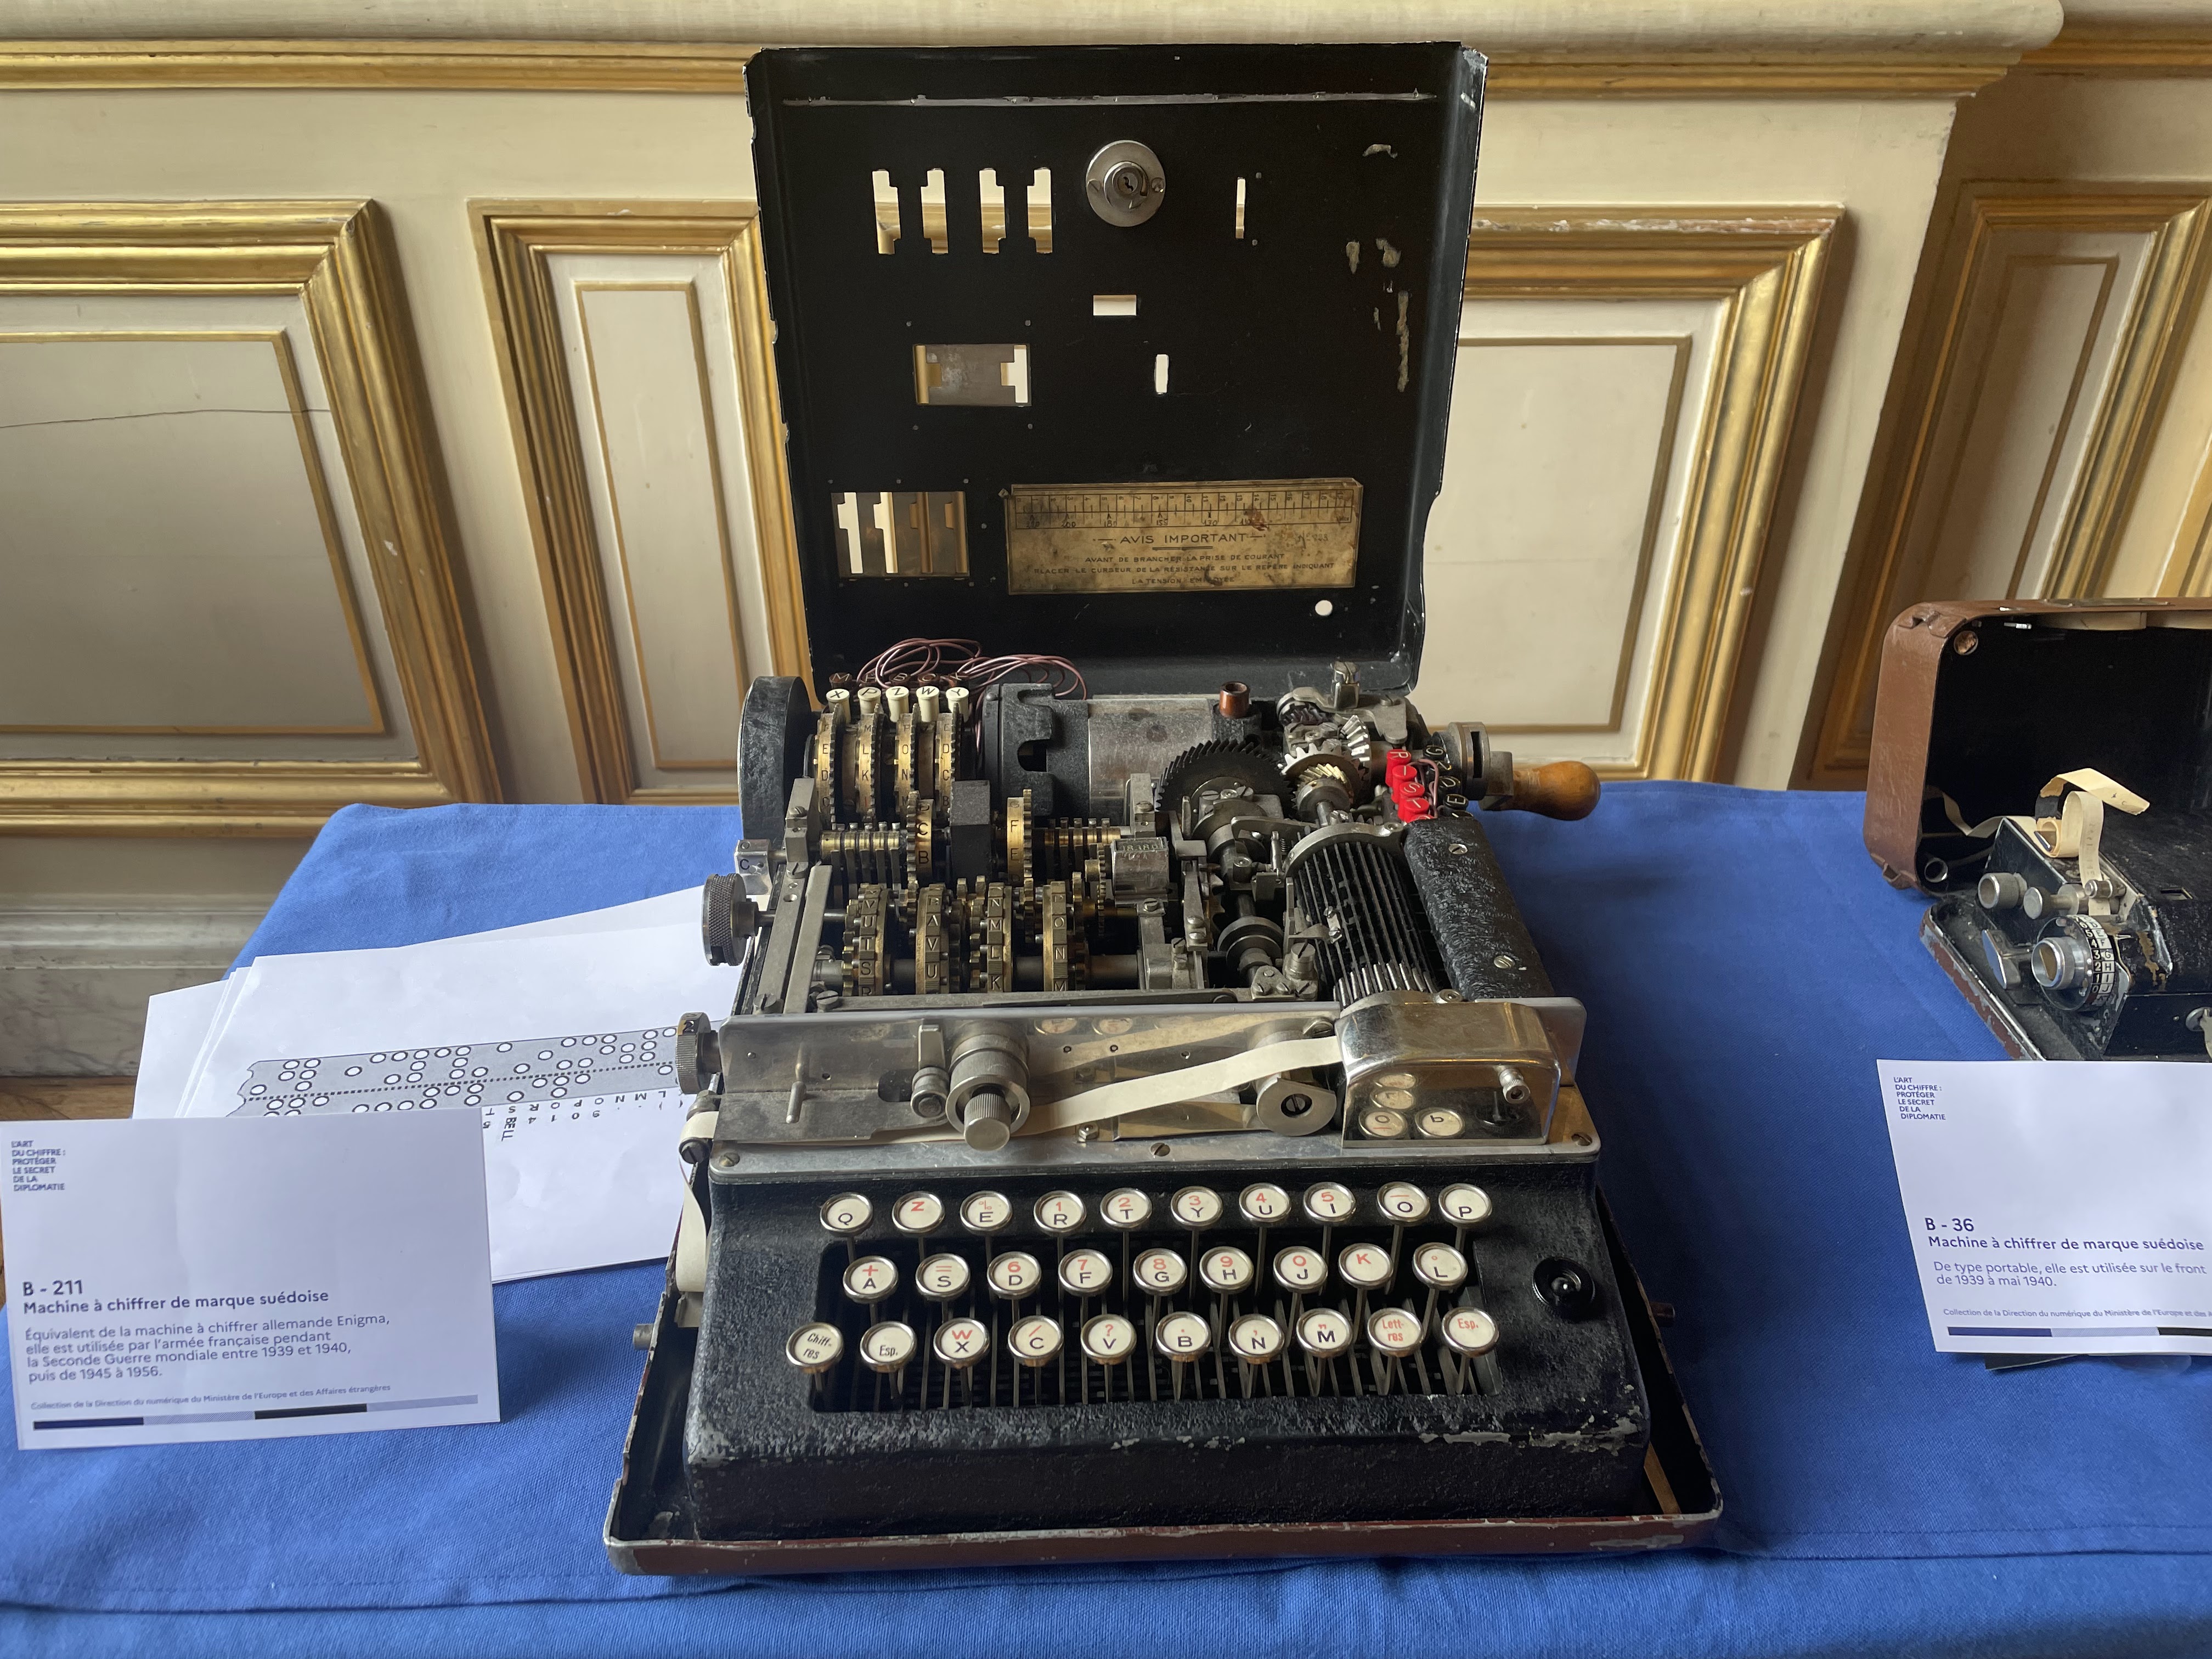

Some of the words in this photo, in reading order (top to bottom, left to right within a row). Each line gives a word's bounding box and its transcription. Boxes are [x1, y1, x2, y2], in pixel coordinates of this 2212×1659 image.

[1120, 535, 1154, 544] AVIS
[1165, 533, 1246, 543] IMPORTANT
[893, 687, 904, 696] Z
[14, 1183, 65, 1192] DIPLOMATIE
[911, 1201, 925, 1211] Z
[1259, 1205, 1273, 1215] U
[1330, 1203, 1336, 1214] I
[1397, 1202, 1414, 1213] O
[1459, 1206, 1472, 1217] P
[979, 1212, 993, 1223] E
[1120, 1209, 1133, 1220] T
[1190, 1207, 1205, 1217] Y
[838, 1212, 853, 1224] Q
[1054, 1214, 1068, 1225] R
[1925, 1217, 1936, 1231] B
[1951, 1218, 1974, 1232] 36
[1928, 1236, 1988, 1248] Machine
[1991, 1237, 2000, 1249] à
[2004, 1237, 2056, 1249] chiffrer
[2061, 1238, 2079, 1249] de
[2083, 1240, 2139, 1252] marque
[2142, 1238, 2204, 1251] suédoise
[1356, 1253, 1372, 1265] K
[1434, 1266, 1448, 1277] L
[1934, 1261, 1951, 1271] De
[1955, 1263, 1983, 1274] type
[1986, 1263, 2042, 1275] portable,
[2045, 1263, 2067, 1273] elle
[2070, 1264, 2090, 1273] est
[2092, 1262, 2137, 1273] utilisée
[2140, 1265, 2158, 1273] sur
[2161, 1263, 2173, 1273] le
[2175, 1263, 2207, 1274] front
[1008, 1275, 1023, 1285] D
[1079, 1272, 1092, 1284] F
[1155, 1271, 1170, 1282] G
[1223, 1269, 1237, 1280] H
[1296, 1269, 1308, 1280] J
[1937, 1274, 1952, 1284] de
[1955, 1275, 1984, 1285] 1939
[1988, 1276, 1995, 1285] à
[1999, 1276, 2021, 1286] mai
[2023, 1277, 2057, 1286] 1940.
[863, 1278, 876, 1289] A
[937, 1276, 952, 1286] S
[22, 1281, 34, 1296] B
[52, 1279, 83, 1295] 211
[24, 1300, 89, 1314] Machine
[94, 1299, 102, 1311] à
[107, 1297, 166, 1311] chiffrer
[171, 1296, 190, 1308] de
[196, 1295, 255, 1309] marque
[260, 1290, 329, 1305] suédoise
[1944, 1308, 1982, 1317] Collection
[2050, 1310, 2091, 1318] numérique
[25, 1327, 95, 1342] Équivalent
[99, 1326, 116, 1338] de
[120, 1325, 131, 1336] la
[136, 1323, 193, 1336] machine
[197, 1323, 204, 1334] à
[208, 1321, 258, 1333] chiffrer
[263, 1317, 332, 1331] allemande
[337, 1314, 390, 1328] Enigma,
[1382, 1318, 1404, 1330] Lett-
[1458, 1318, 1479, 1330] Esp.
[951, 1329, 973, 1340] W
[1317, 1330, 1336, 1343] M
[1387, 1331, 1403, 1342] res
[26, 1343, 49, 1355] elle
[53, 1344, 74, 1354] est
[77, 1340, 124, 1353] utilisée
[128, 1341, 150, 1353] par
[154, 1337, 204, 1350] l'armée
[208, 1334, 269, 1347] française
[274, 1331, 331, 1345] pendant
[808, 1333, 832, 1348] Chiff-
[1029, 1337, 1043, 1349] C
[1102, 1338, 1116, 1349] V
[1177, 1336, 1192, 1347] B
[1252, 1337, 1265, 1349] N
[879, 1345, 898, 1358] Esp.
[955, 1342, 969, 1352] X
[27, 1356, 38, 1367] la
[43, 1353, 100, 1367] Seconde
[105, 1353, 151, 1365] Guerre
[156, 1349, 218, 1362] mondiale
[222, 1348, 258, 1359] entre
[262, 1345, 294, 1357] 1939
[298, 1345, 312, 1355] et
[315, 1342, 351, 1354] 1940,
[803, 1347, 819, 1360] res
[29, 1370, 55, 1385] puis
[59, 1369, 76, 1380] de
[80, 1367, 111, 1379] 1945
[116, 1367, 123, 1378] à
[126, 1365, 162, 1377] 1956.
[203, 1394, 240, 1402] Ministère
[349, 1385, 391, 1393] étrangères
